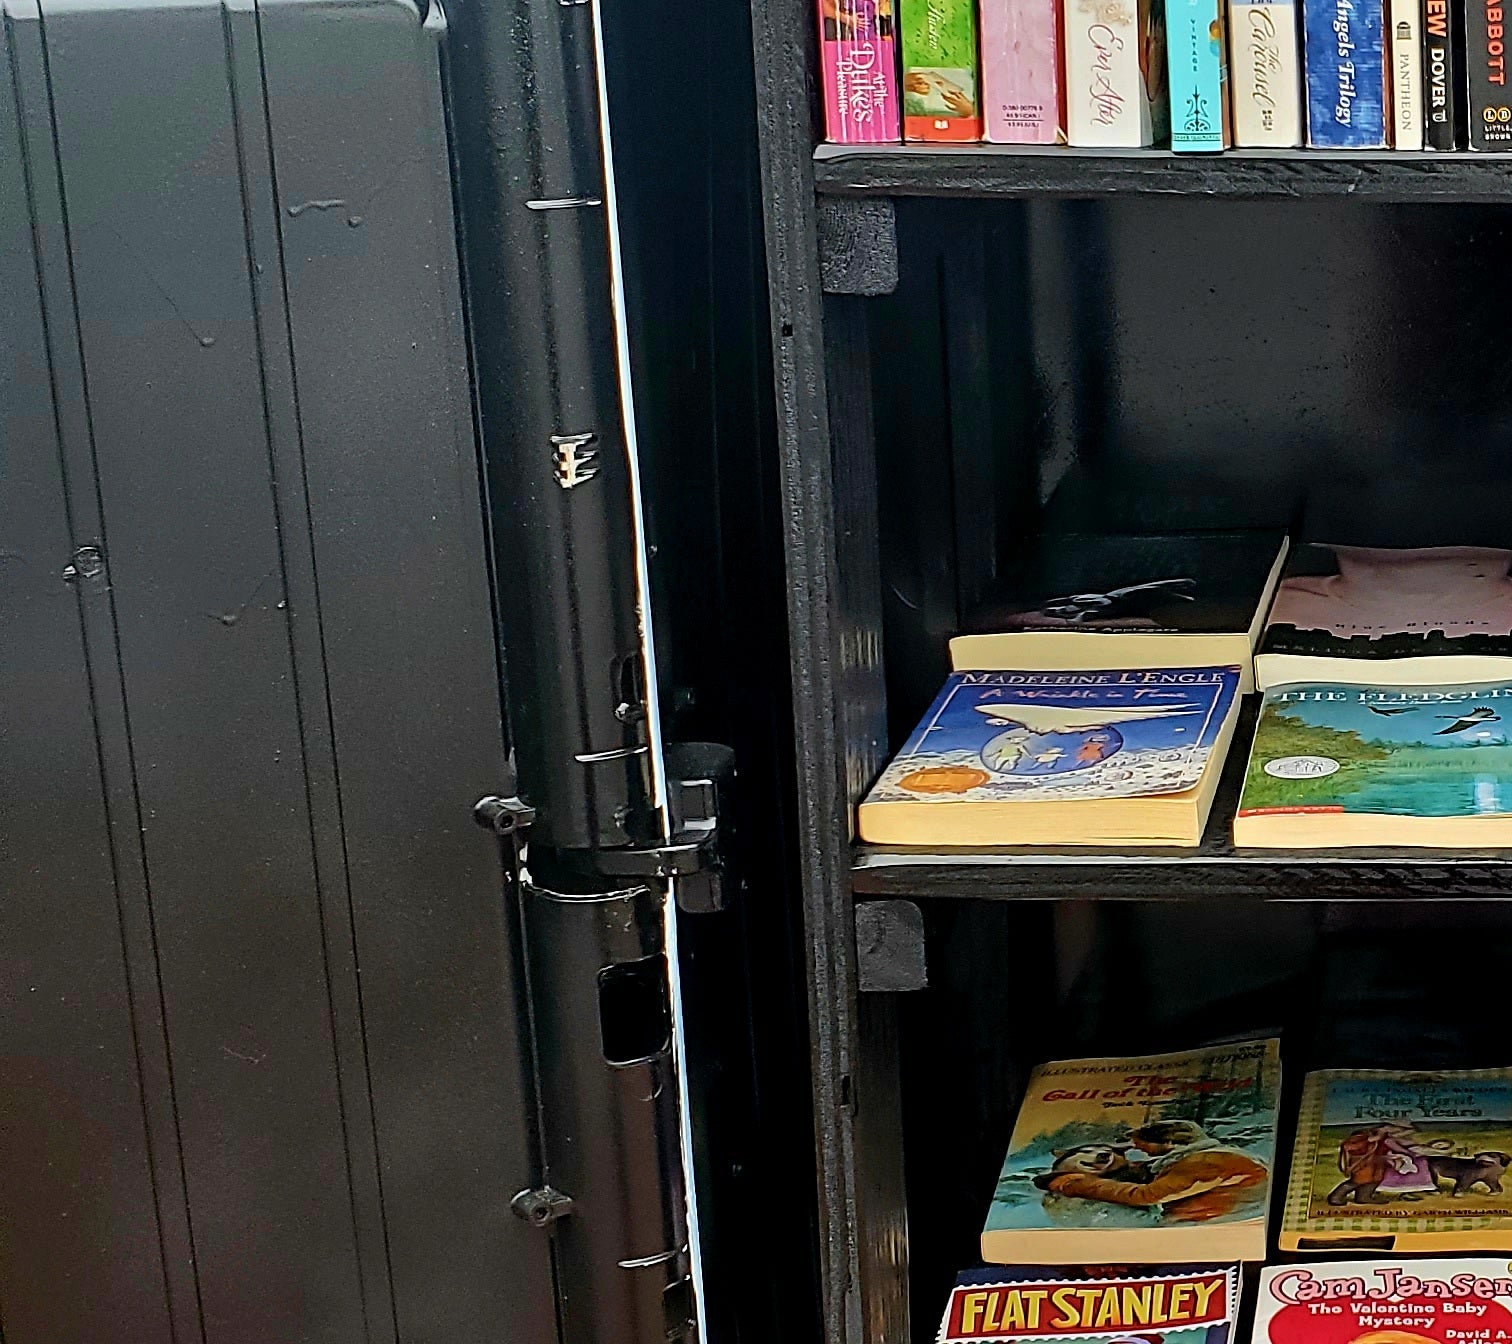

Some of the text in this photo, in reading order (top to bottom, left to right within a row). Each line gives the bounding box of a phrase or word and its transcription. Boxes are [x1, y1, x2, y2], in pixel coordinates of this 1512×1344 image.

[1430, 48, 1446, 108] DOVER
[1333, 57, 1358, 129] Trilogy
[1399, 54, 1413, 132] PANTHEON
[962, 672, 1226, 684] MADELEINE L'ENGLE
[1278, 690, 1347, 703] THE
[1268, 1269, 1367, 1305] Cam
[961, 1278, 1225, 1334] FLAT STANLEY
[1307, 1302, 1488, 1317] The Valentine Baby
[1357, 1315, 1436, 1329] Mystery
[1445, 1329, 1512, 1340] David A.
